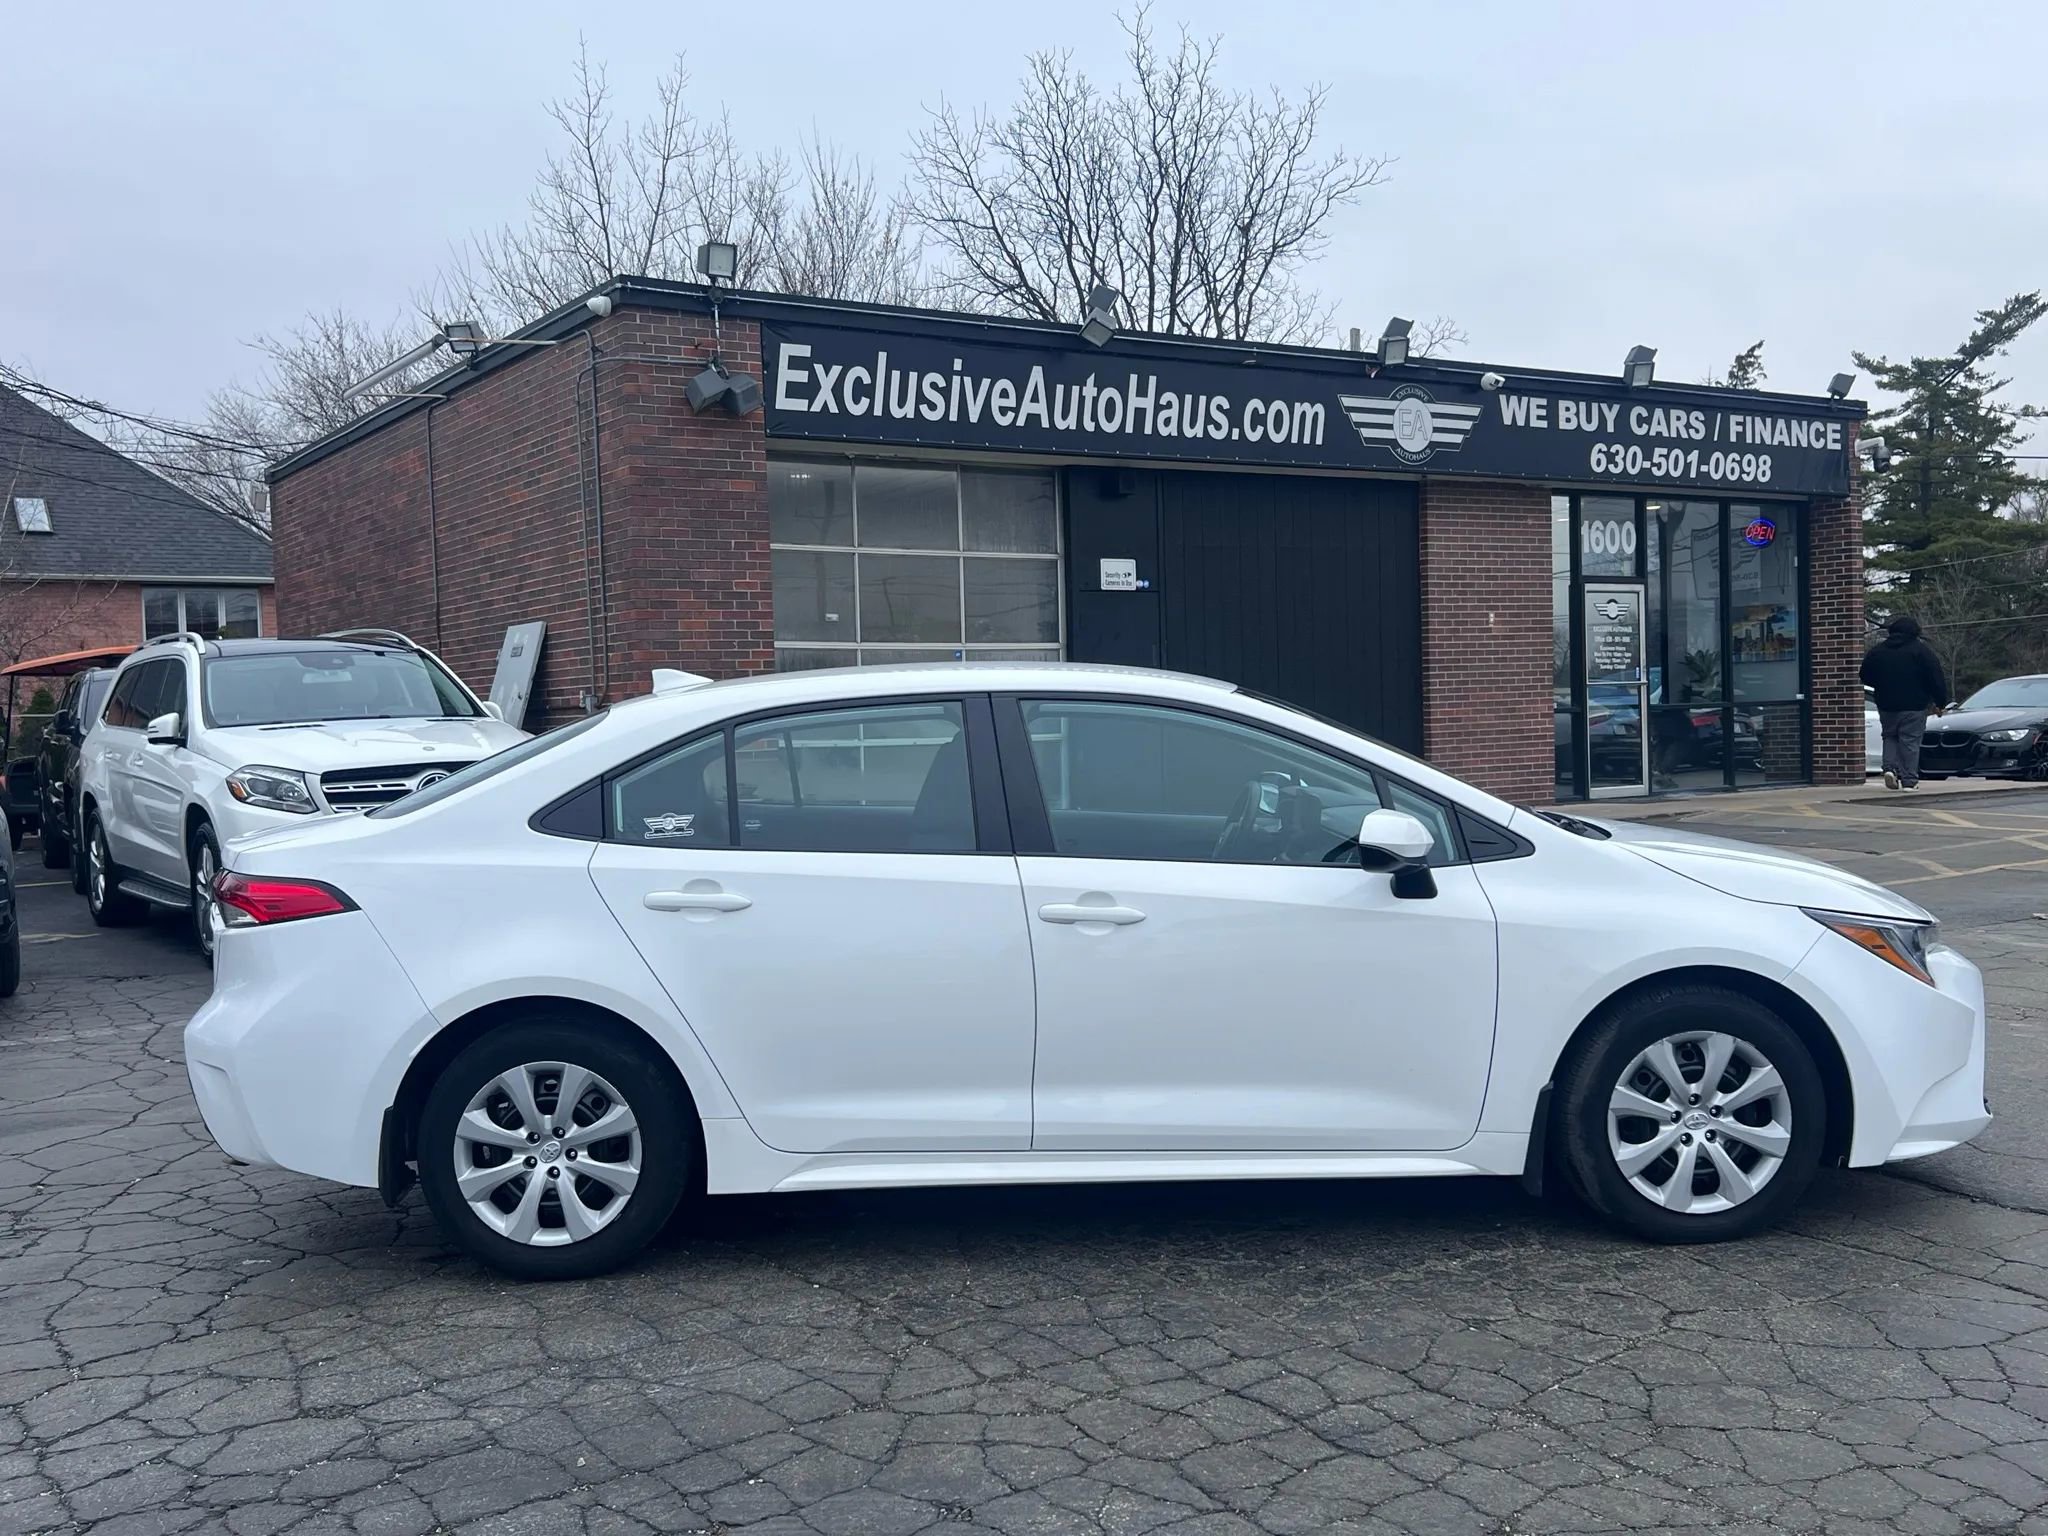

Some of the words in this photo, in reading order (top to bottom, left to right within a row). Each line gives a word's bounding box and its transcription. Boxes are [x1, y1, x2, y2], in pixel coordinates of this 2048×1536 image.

[775, 343, 1326, 446] ExclusiveAutoHaus.com
[1396, 387, 1430, 401] EXCLUSIVE
[1399, 408, 1428, 440] EA
[1499, 394, 1548, 428] WE
[1558, 400, 1621, 433] BUY
[1630, 406, 1706, 441] CARS
[1713, 412, 1722, 442] /
[1729, 414, 1842, 450] FINANCE
[1395, 447, 1432, 461] AUTOHAUS
[1590, 443, 1772, 483] 630-501-0698
[1581, 520, 1637, 554] 1600
[1746, 525, 1775, 540] OPEN
